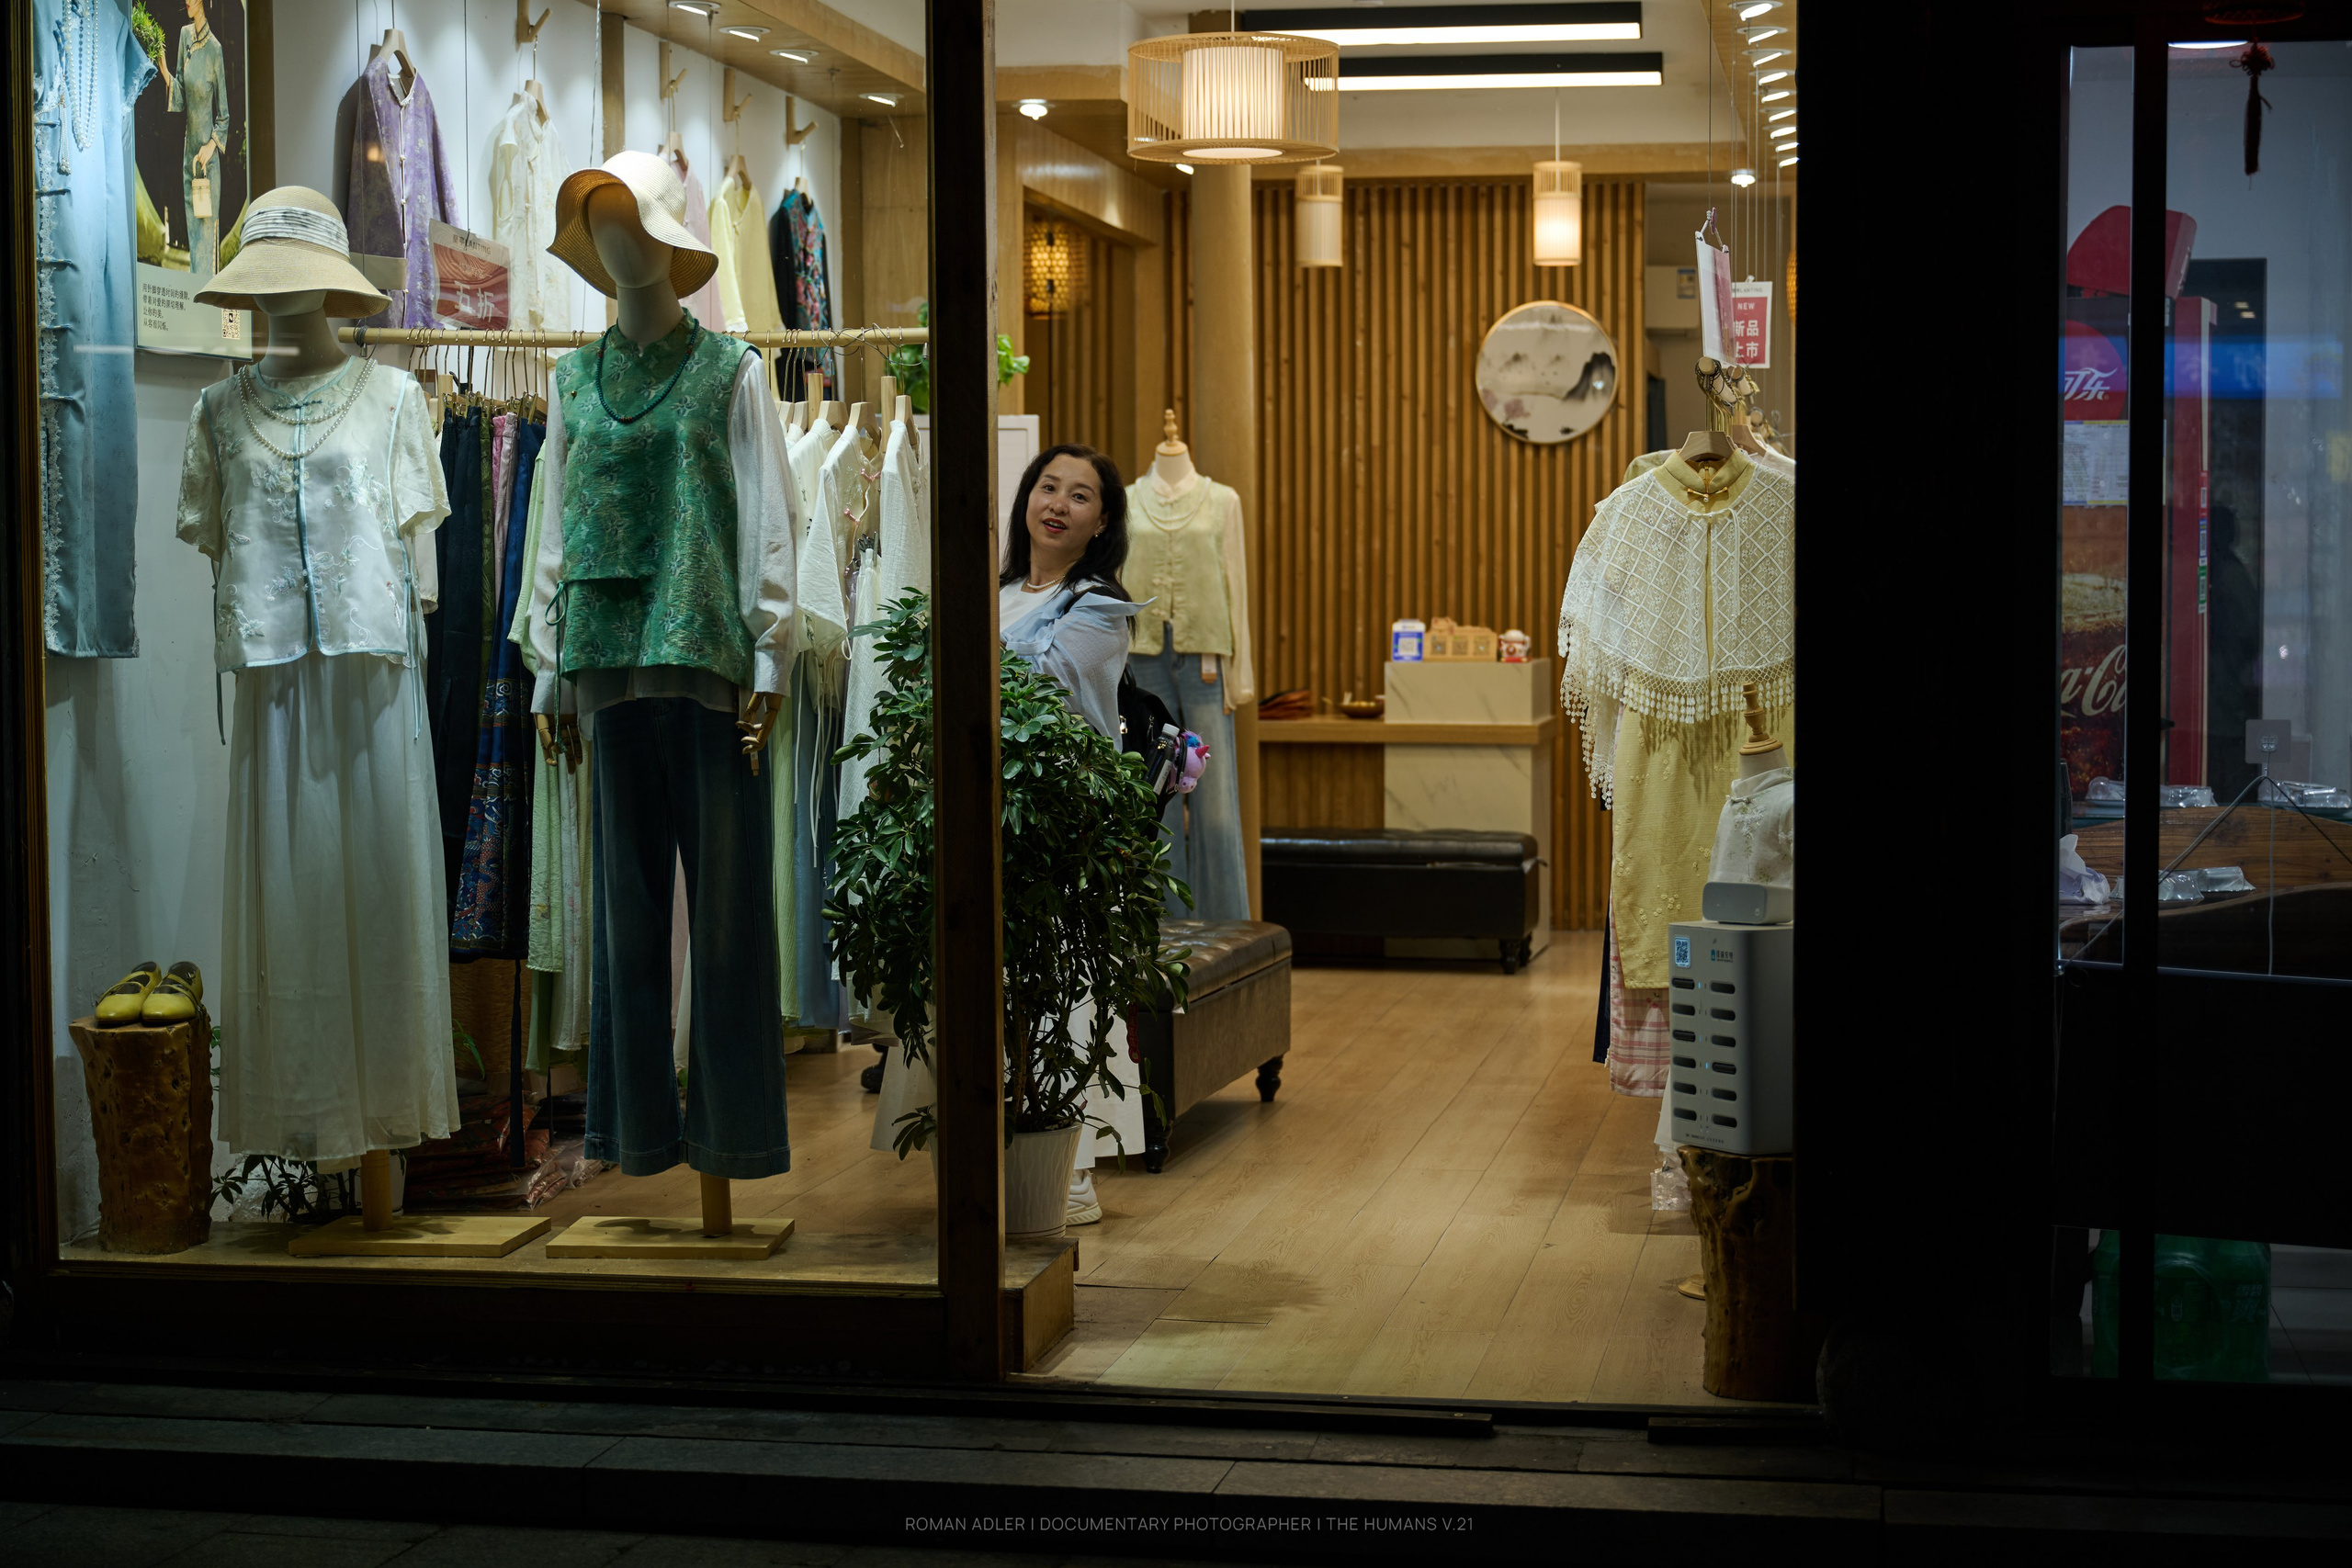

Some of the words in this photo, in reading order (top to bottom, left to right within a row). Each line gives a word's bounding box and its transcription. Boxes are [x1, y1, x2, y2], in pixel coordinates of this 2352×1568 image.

[454, 280, 494, 322] 五折
[1734, 320, 1758, 337] 新品
[1736, 342, 1758, 358] 上市
